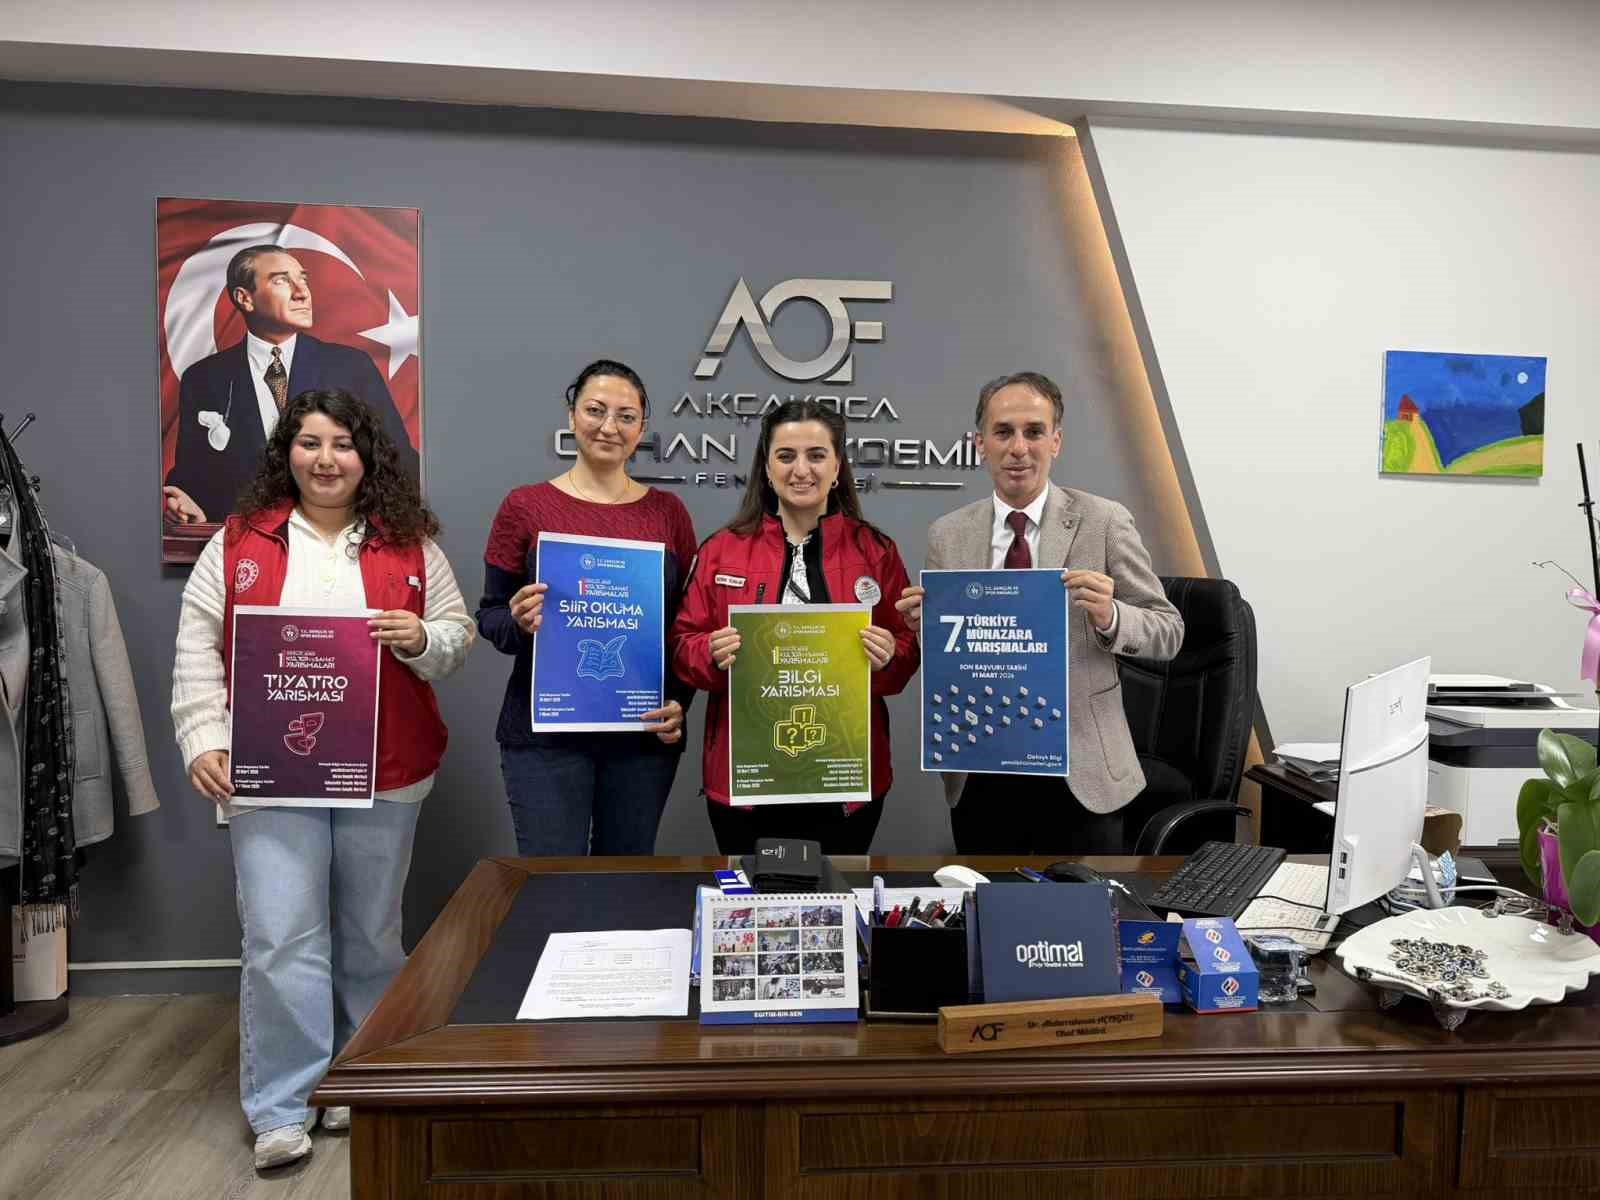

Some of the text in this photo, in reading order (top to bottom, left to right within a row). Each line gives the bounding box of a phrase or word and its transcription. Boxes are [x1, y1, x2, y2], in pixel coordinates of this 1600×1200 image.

[695, 277, 892, 383] AOF
[591, 602, 644, 616] OKUMA
[1016, 940, 1083, 968] optimal
